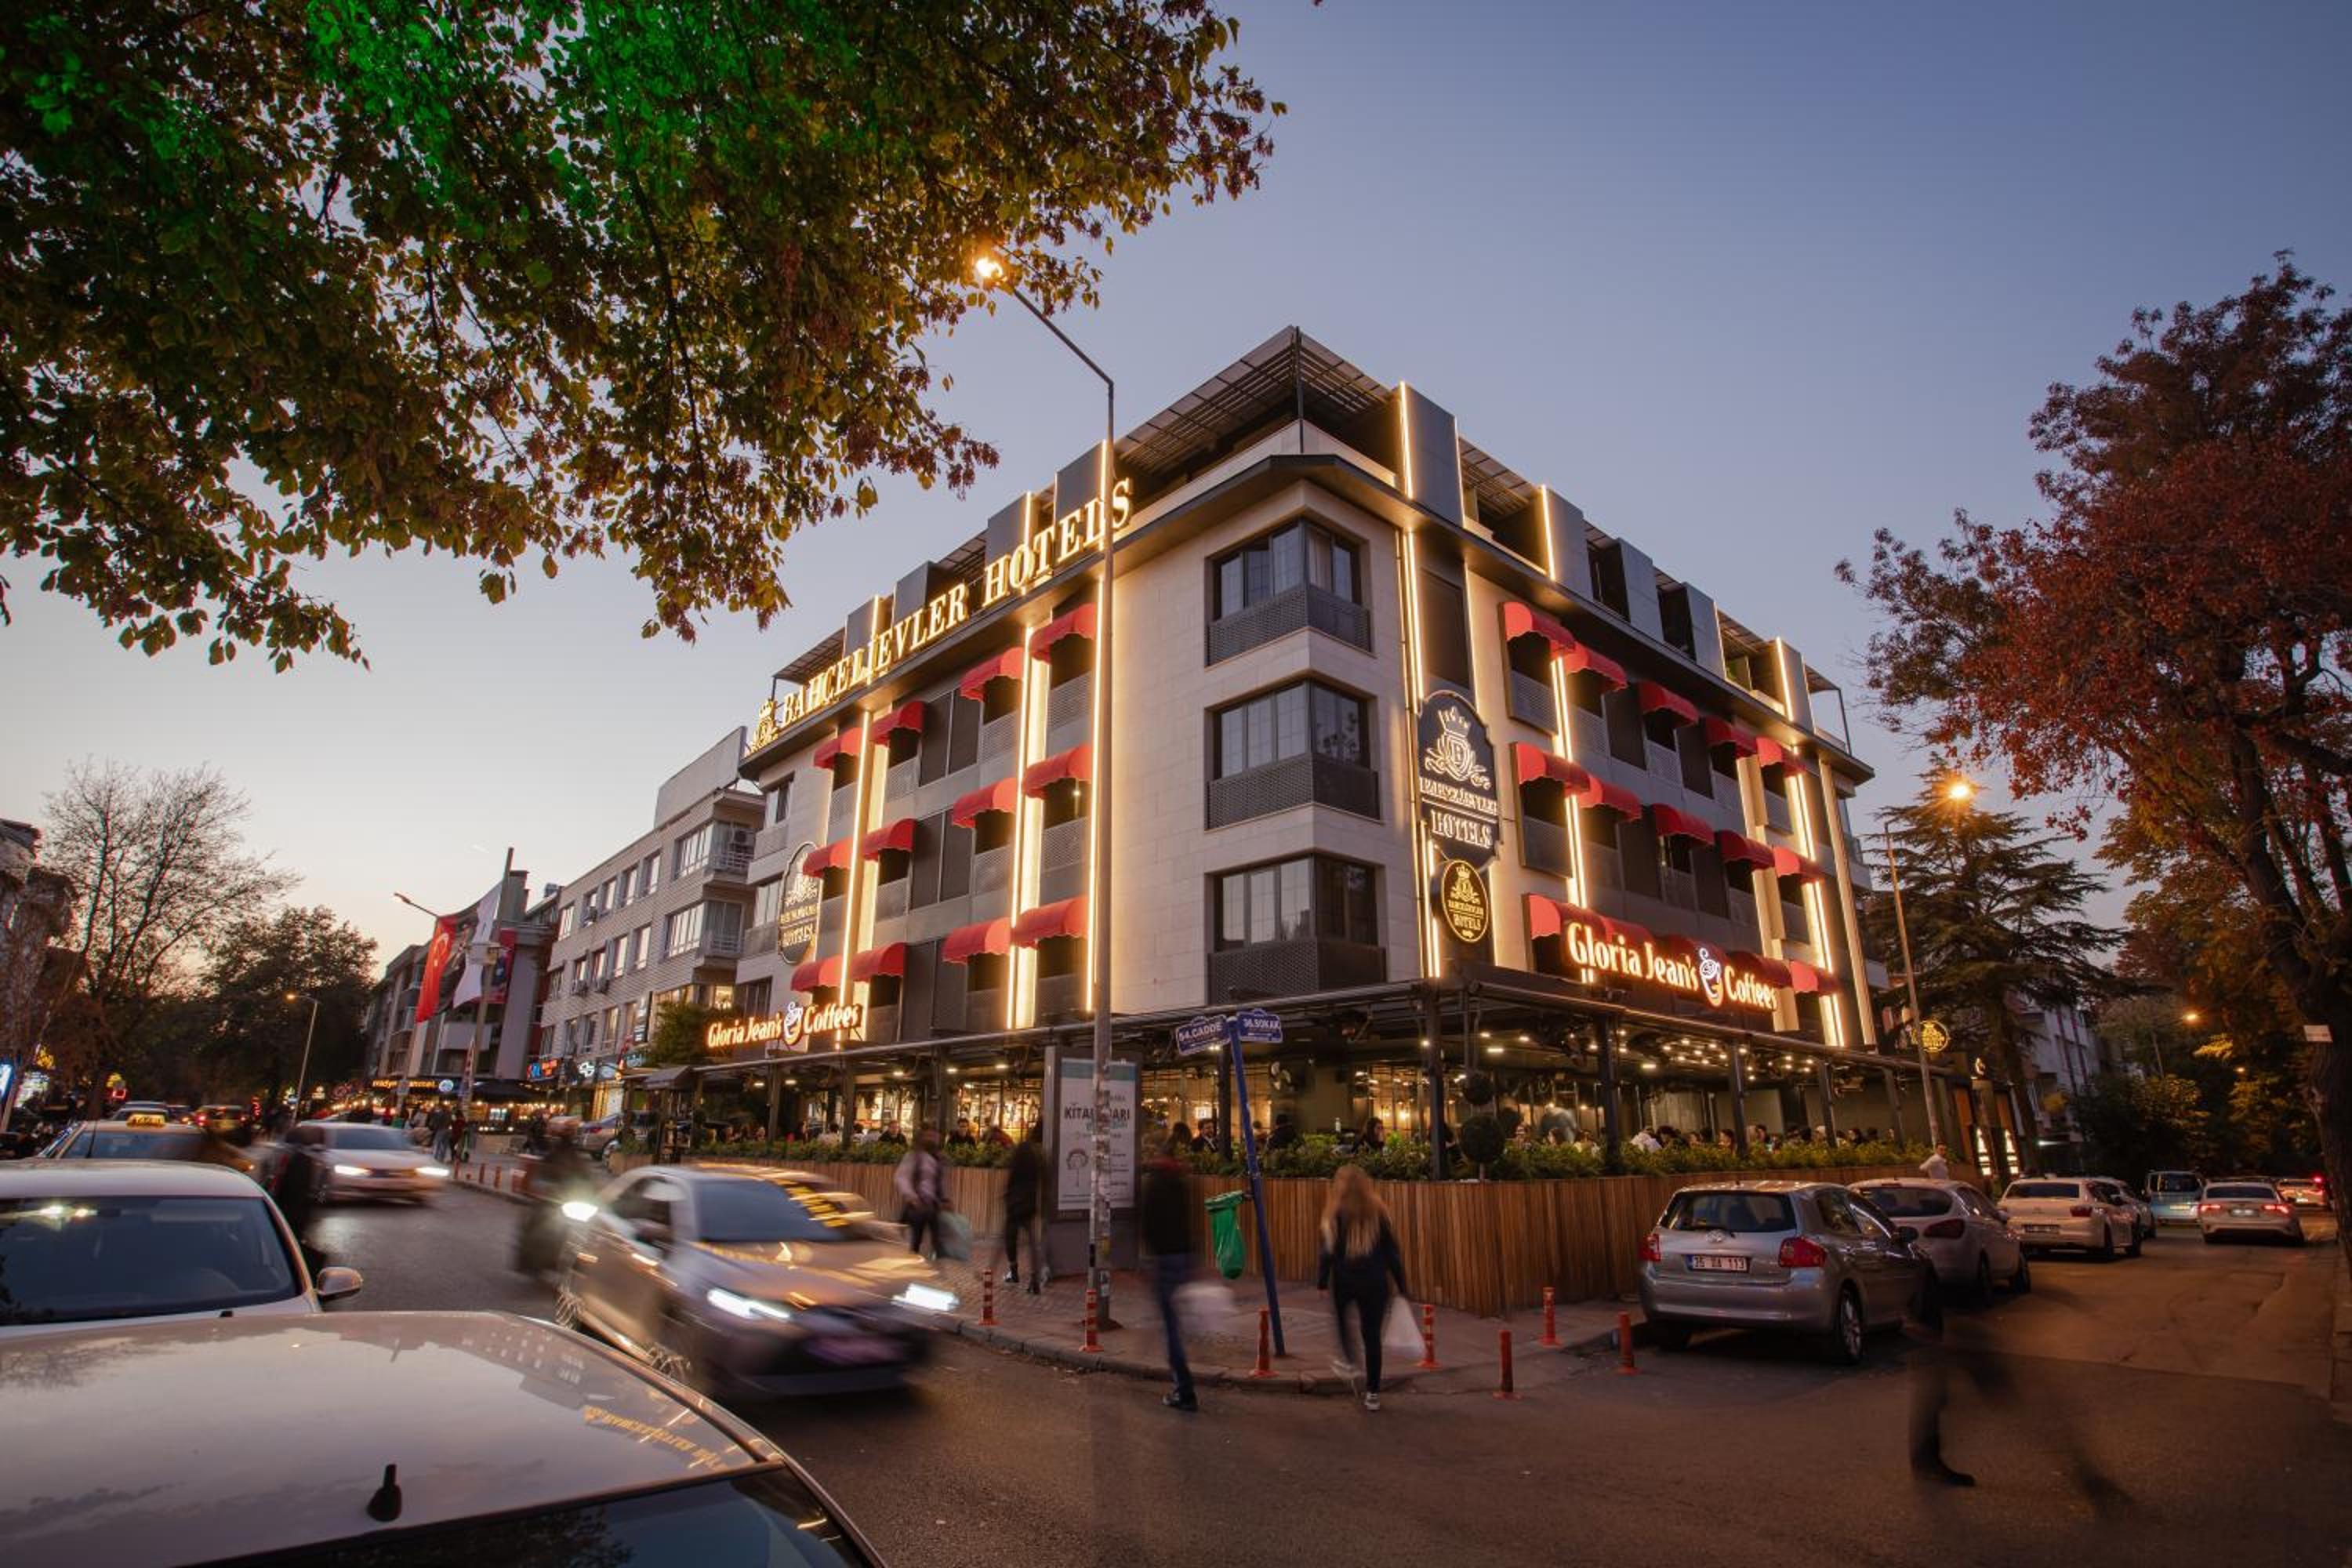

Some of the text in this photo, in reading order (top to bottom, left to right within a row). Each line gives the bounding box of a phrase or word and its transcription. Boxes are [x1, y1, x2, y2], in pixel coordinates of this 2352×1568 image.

[1430, 808, 1494, 849] HOTELS
[1568, 922, 1778, 1010] Gloria Jean's Coffees
[707, 1004, 858, 1047] Gloria Jean's Coffees
